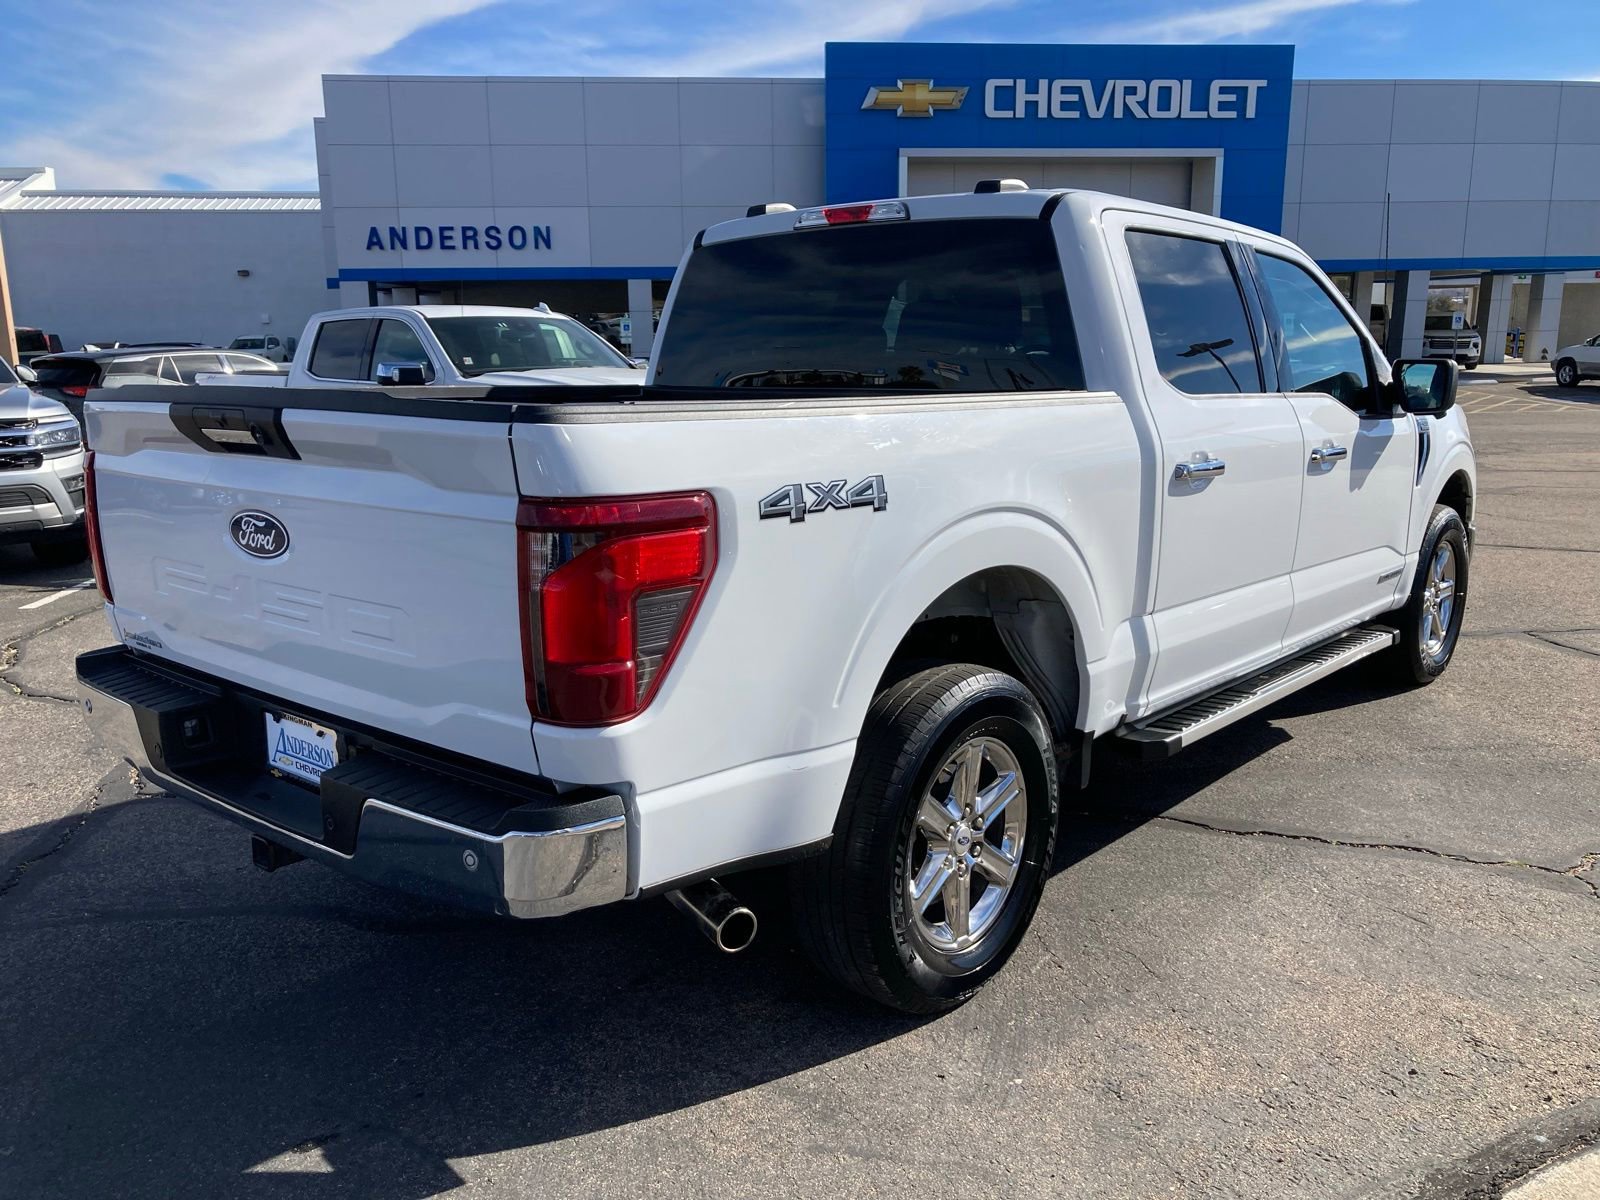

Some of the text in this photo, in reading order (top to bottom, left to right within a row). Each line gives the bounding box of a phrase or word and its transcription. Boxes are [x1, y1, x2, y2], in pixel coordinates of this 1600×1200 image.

[984, 78, 1268, 119] CHEVROLET
[365, 225, 553, 251] ANDERSON
[238, 517, 276, 550] Ford
[272, 727, 334, 767] ANDERSON
[894, 813, 912, 947] HERCULE
